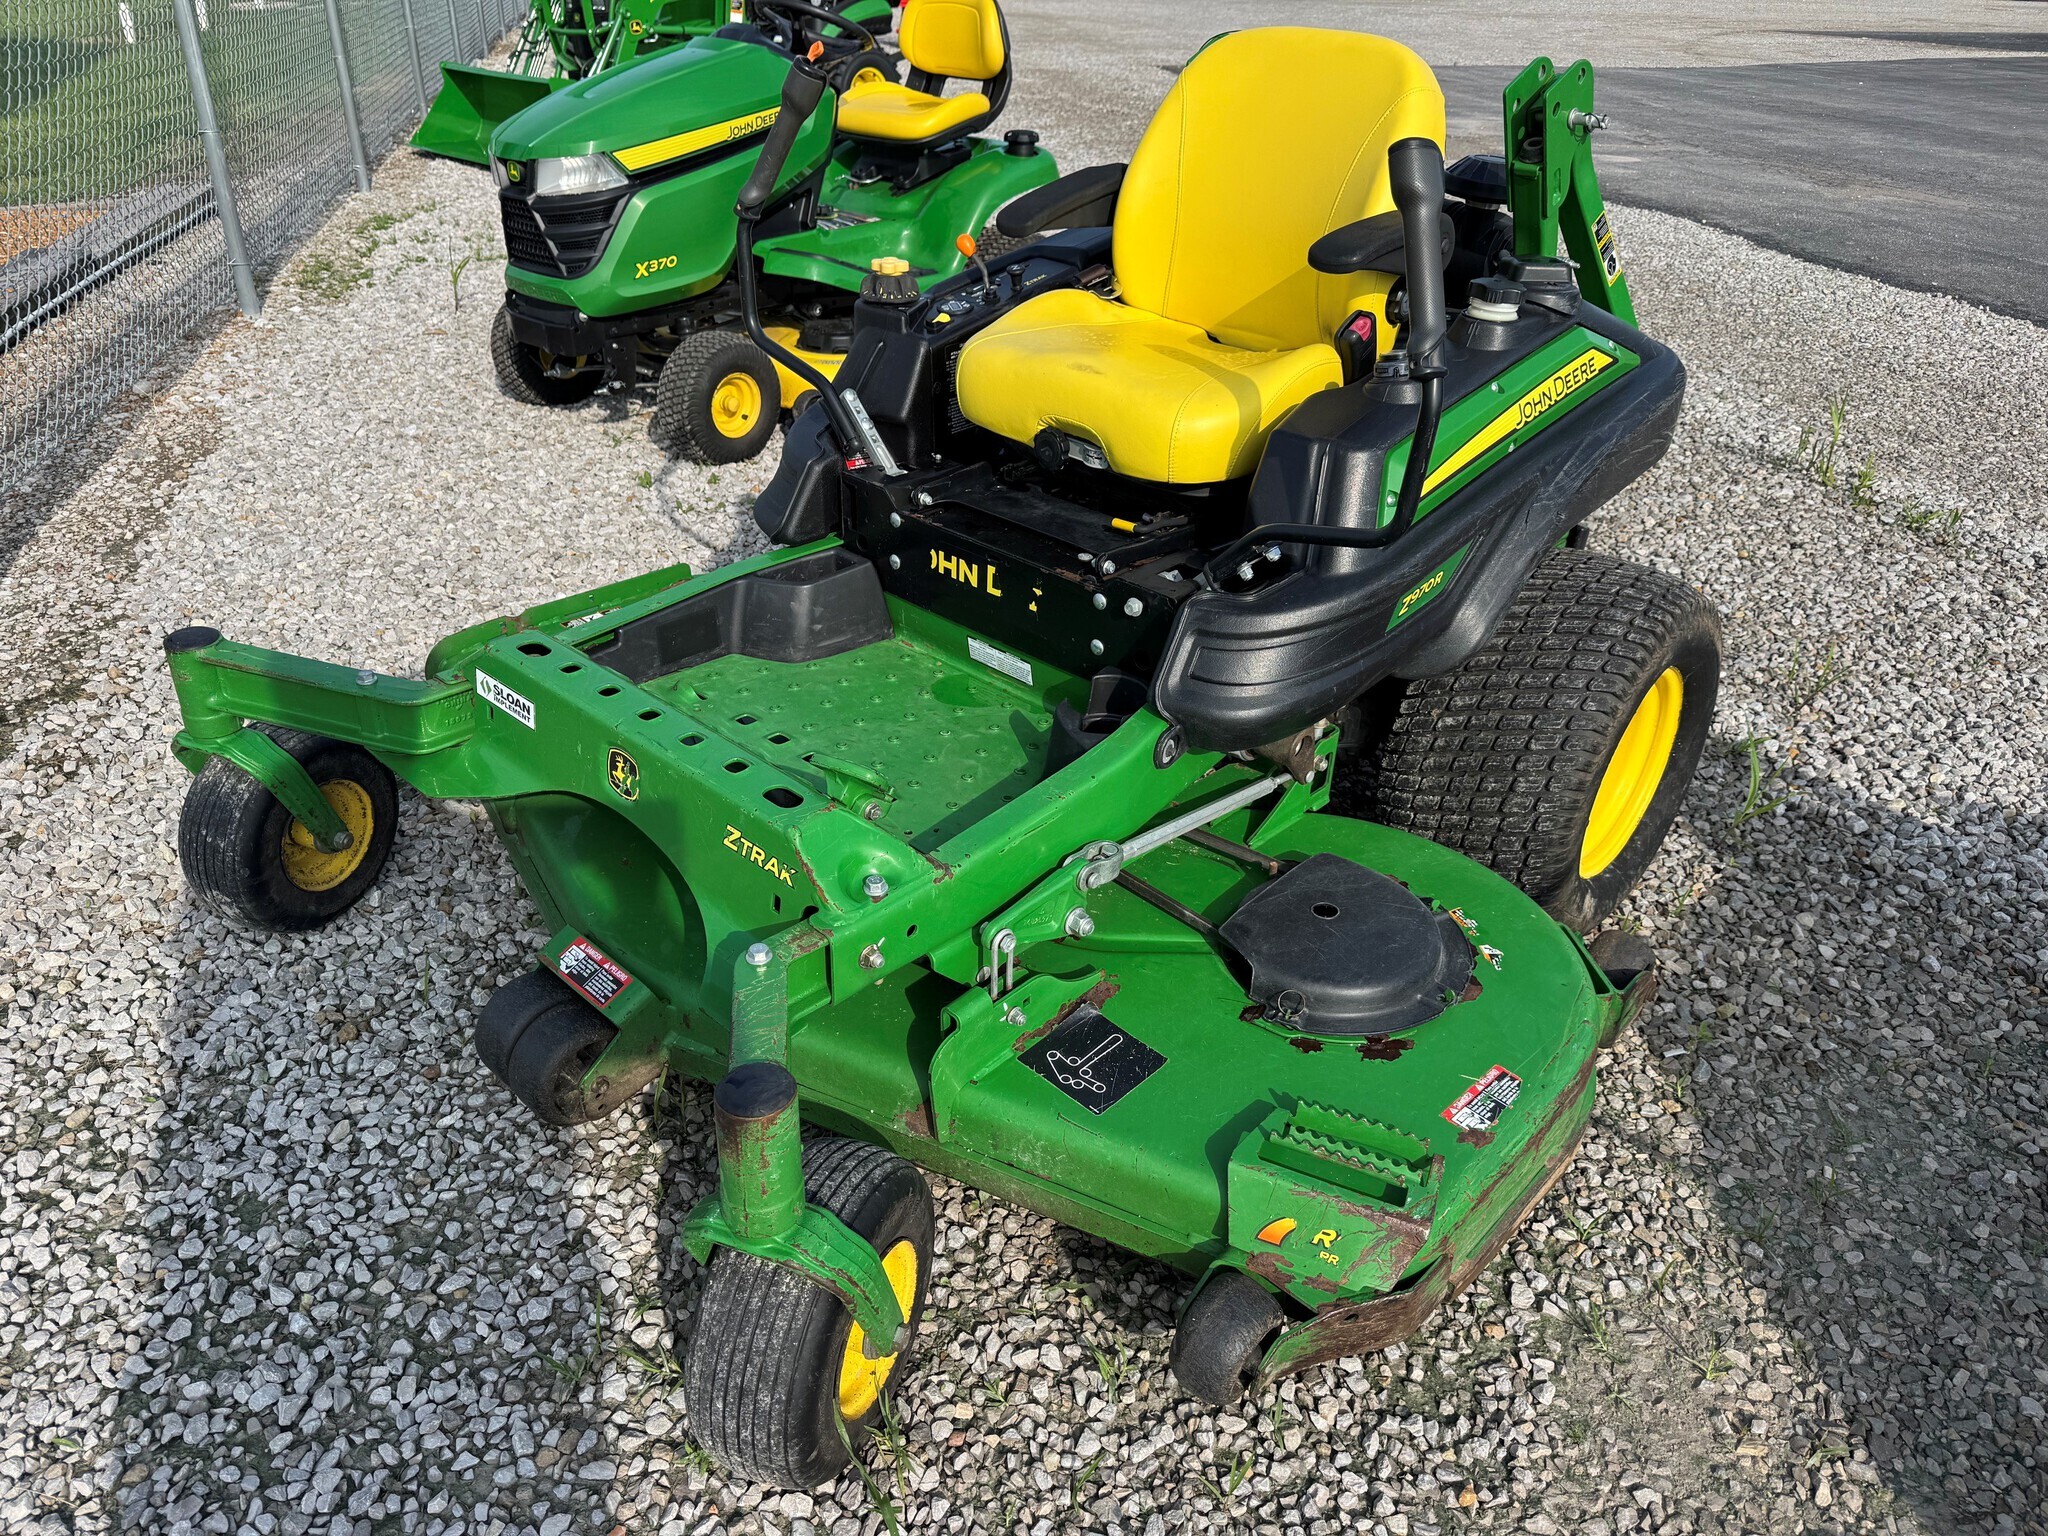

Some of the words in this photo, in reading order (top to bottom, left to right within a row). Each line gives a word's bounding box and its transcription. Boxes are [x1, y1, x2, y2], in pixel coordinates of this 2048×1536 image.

[726, 120, 754, 139] JOHN
[755, 111, 779, 128] DEE
[634, 254, 678, 279] X370
[1516, 386, 1553, 426] JOHN
[1553, 356, 1597, 398] DEERE
[1398, 571, 1444, 617] Z970R
[493, 684, 531, 716] SLOAN
[493, 693, 531, 723] IMPLEMENT
[722, 823, 798, 889] ZTRAK
